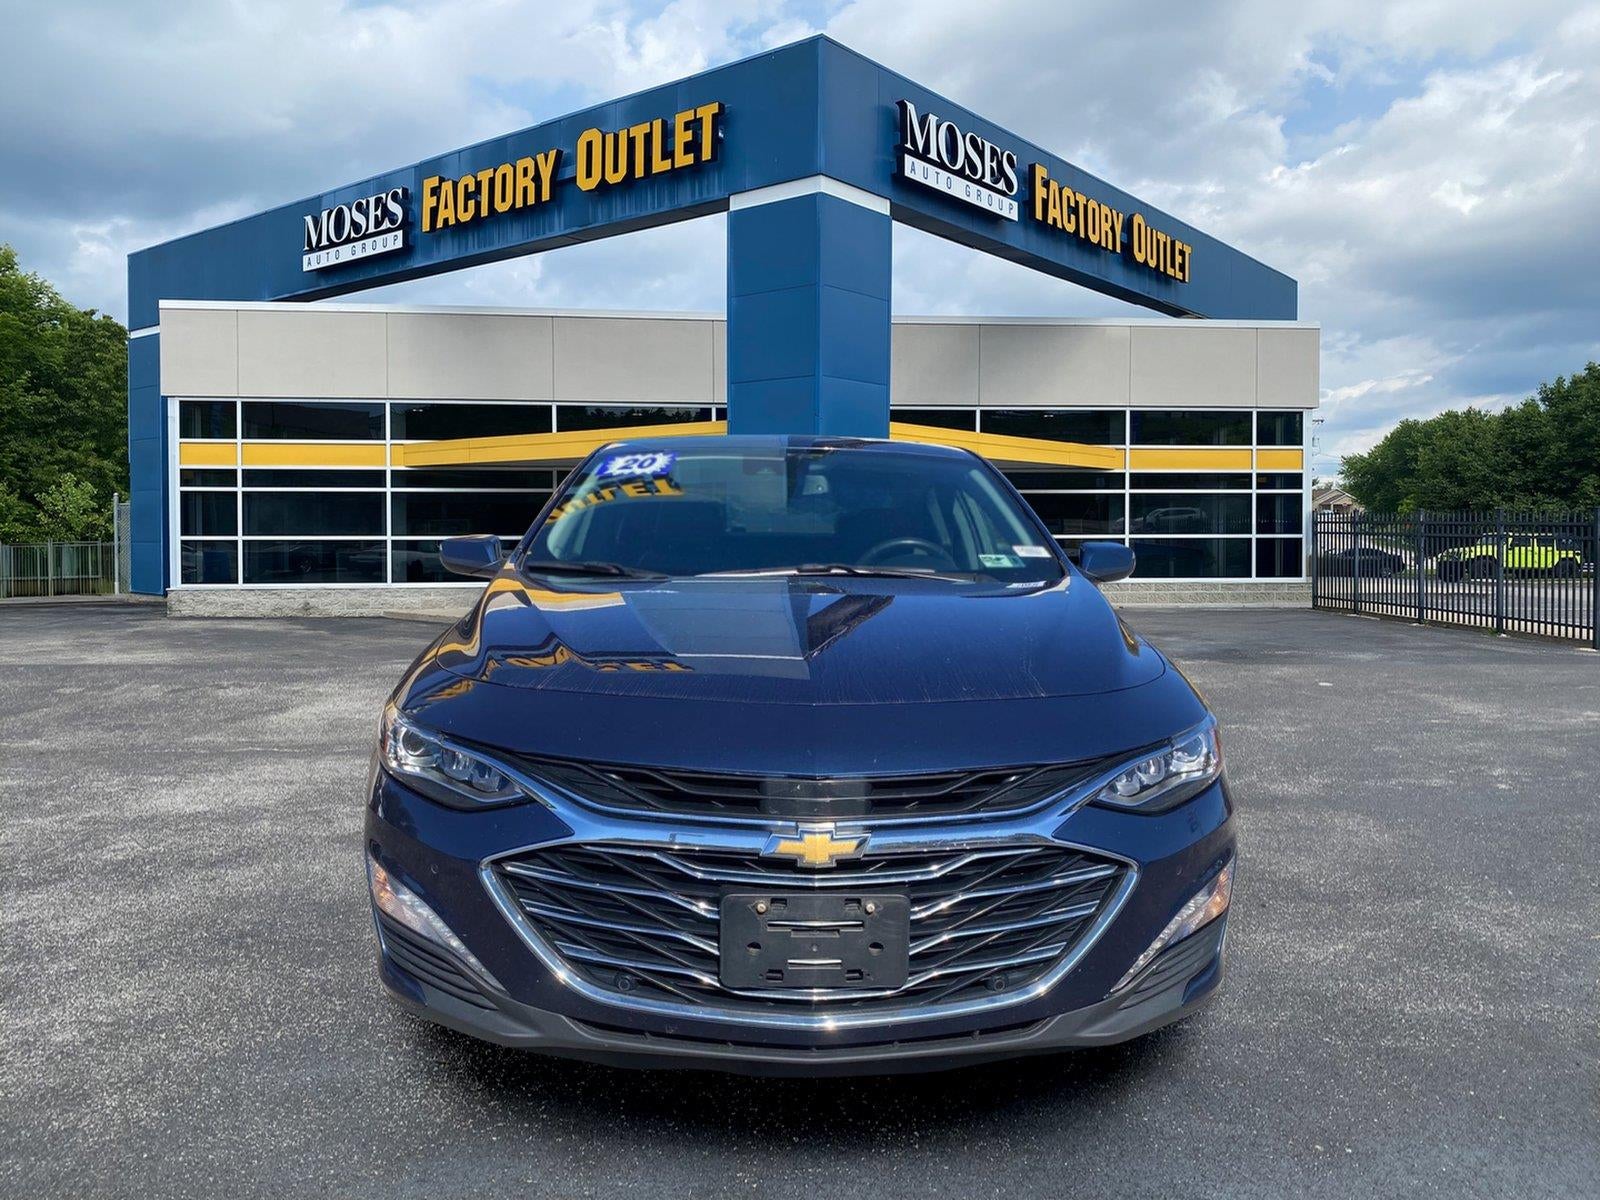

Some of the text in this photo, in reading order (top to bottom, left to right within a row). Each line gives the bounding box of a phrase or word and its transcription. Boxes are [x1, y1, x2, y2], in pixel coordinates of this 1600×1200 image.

[422, 101, 721, 232] FACTORY OUTLET
[904, 100, 1019, 196] MOSES
[303, 187, 404, 251] MOSES
[910, 160, 1015, 215] AUTO GROUP
[306, 234, 399, 268] AUTO GROUP
[1035, 163, 1192, 283] FACTORY OUTLET
[617, 457, 658, 470] 20
